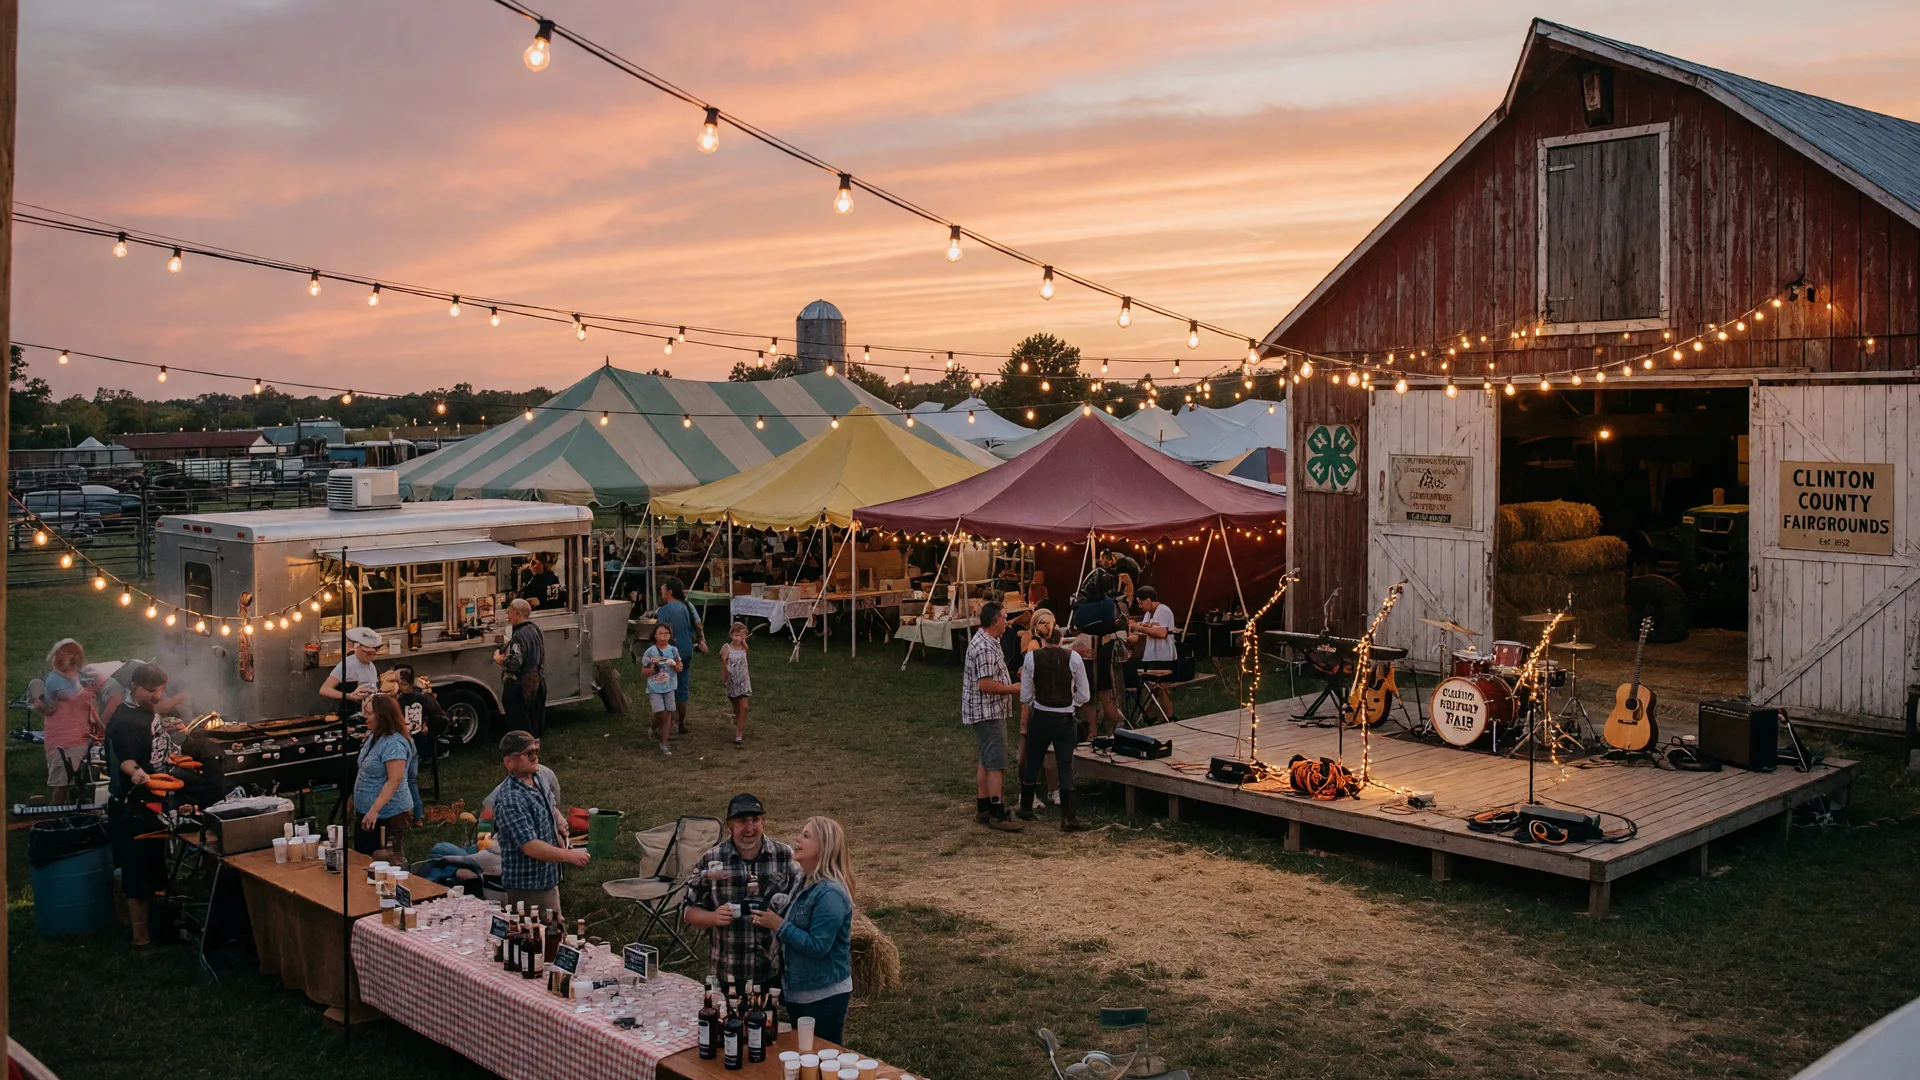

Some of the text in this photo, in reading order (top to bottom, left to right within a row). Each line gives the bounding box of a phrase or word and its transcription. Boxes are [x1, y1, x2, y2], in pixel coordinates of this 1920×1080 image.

[1793, 469, 1875, 489] CLINTON
[1798, 492, 1872, 512] COUNTY
[1783, 515, 1890, 534] FAIRGROUNDS
